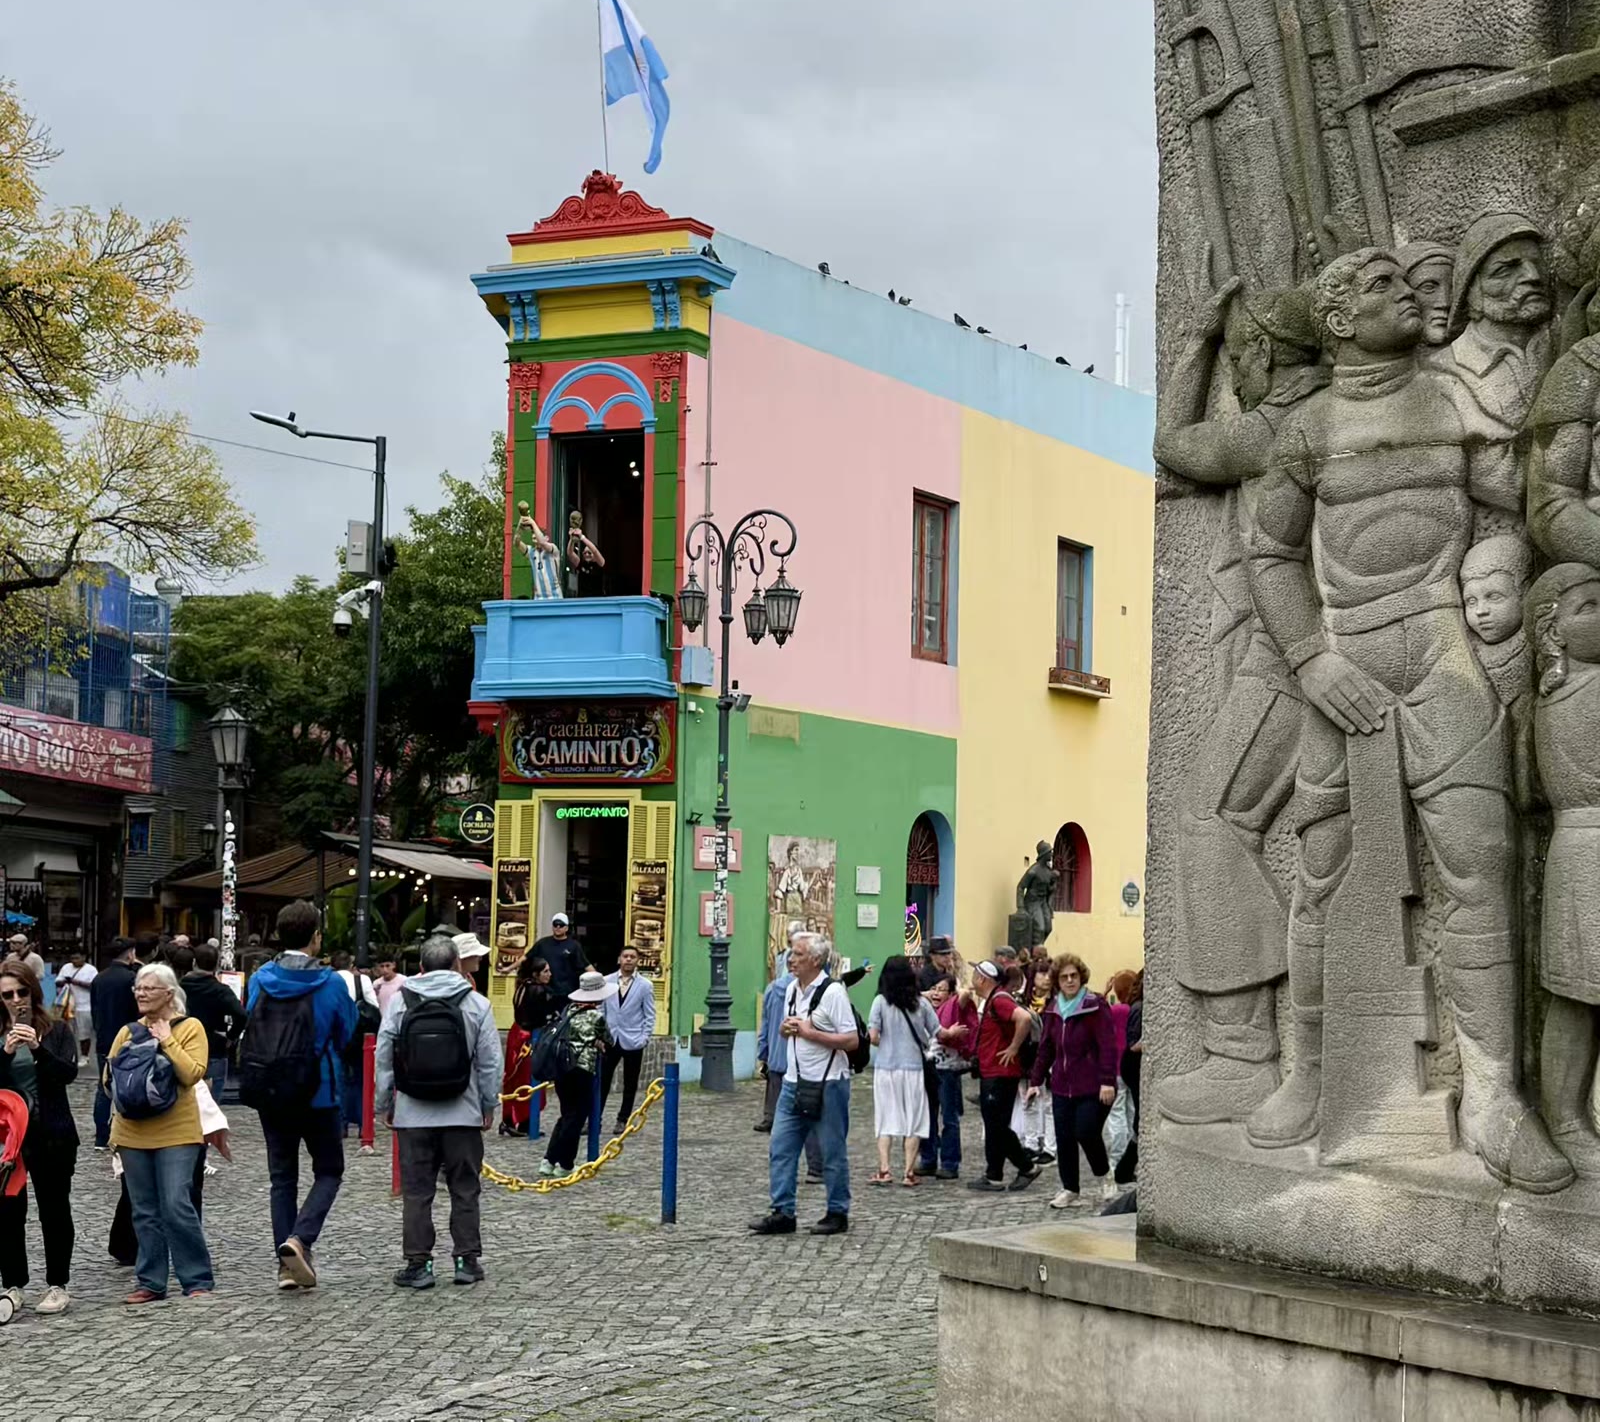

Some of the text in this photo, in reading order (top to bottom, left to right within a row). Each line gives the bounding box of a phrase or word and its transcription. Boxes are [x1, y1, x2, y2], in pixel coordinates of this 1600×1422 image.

[529, 736, 642, 766] CAMINITO
[556, 806, 629, 819] @VISITCAMINITO
[499, 864, 530, 873] ALFAJOR
[634, 865, 666, 874] ALFAJOR
